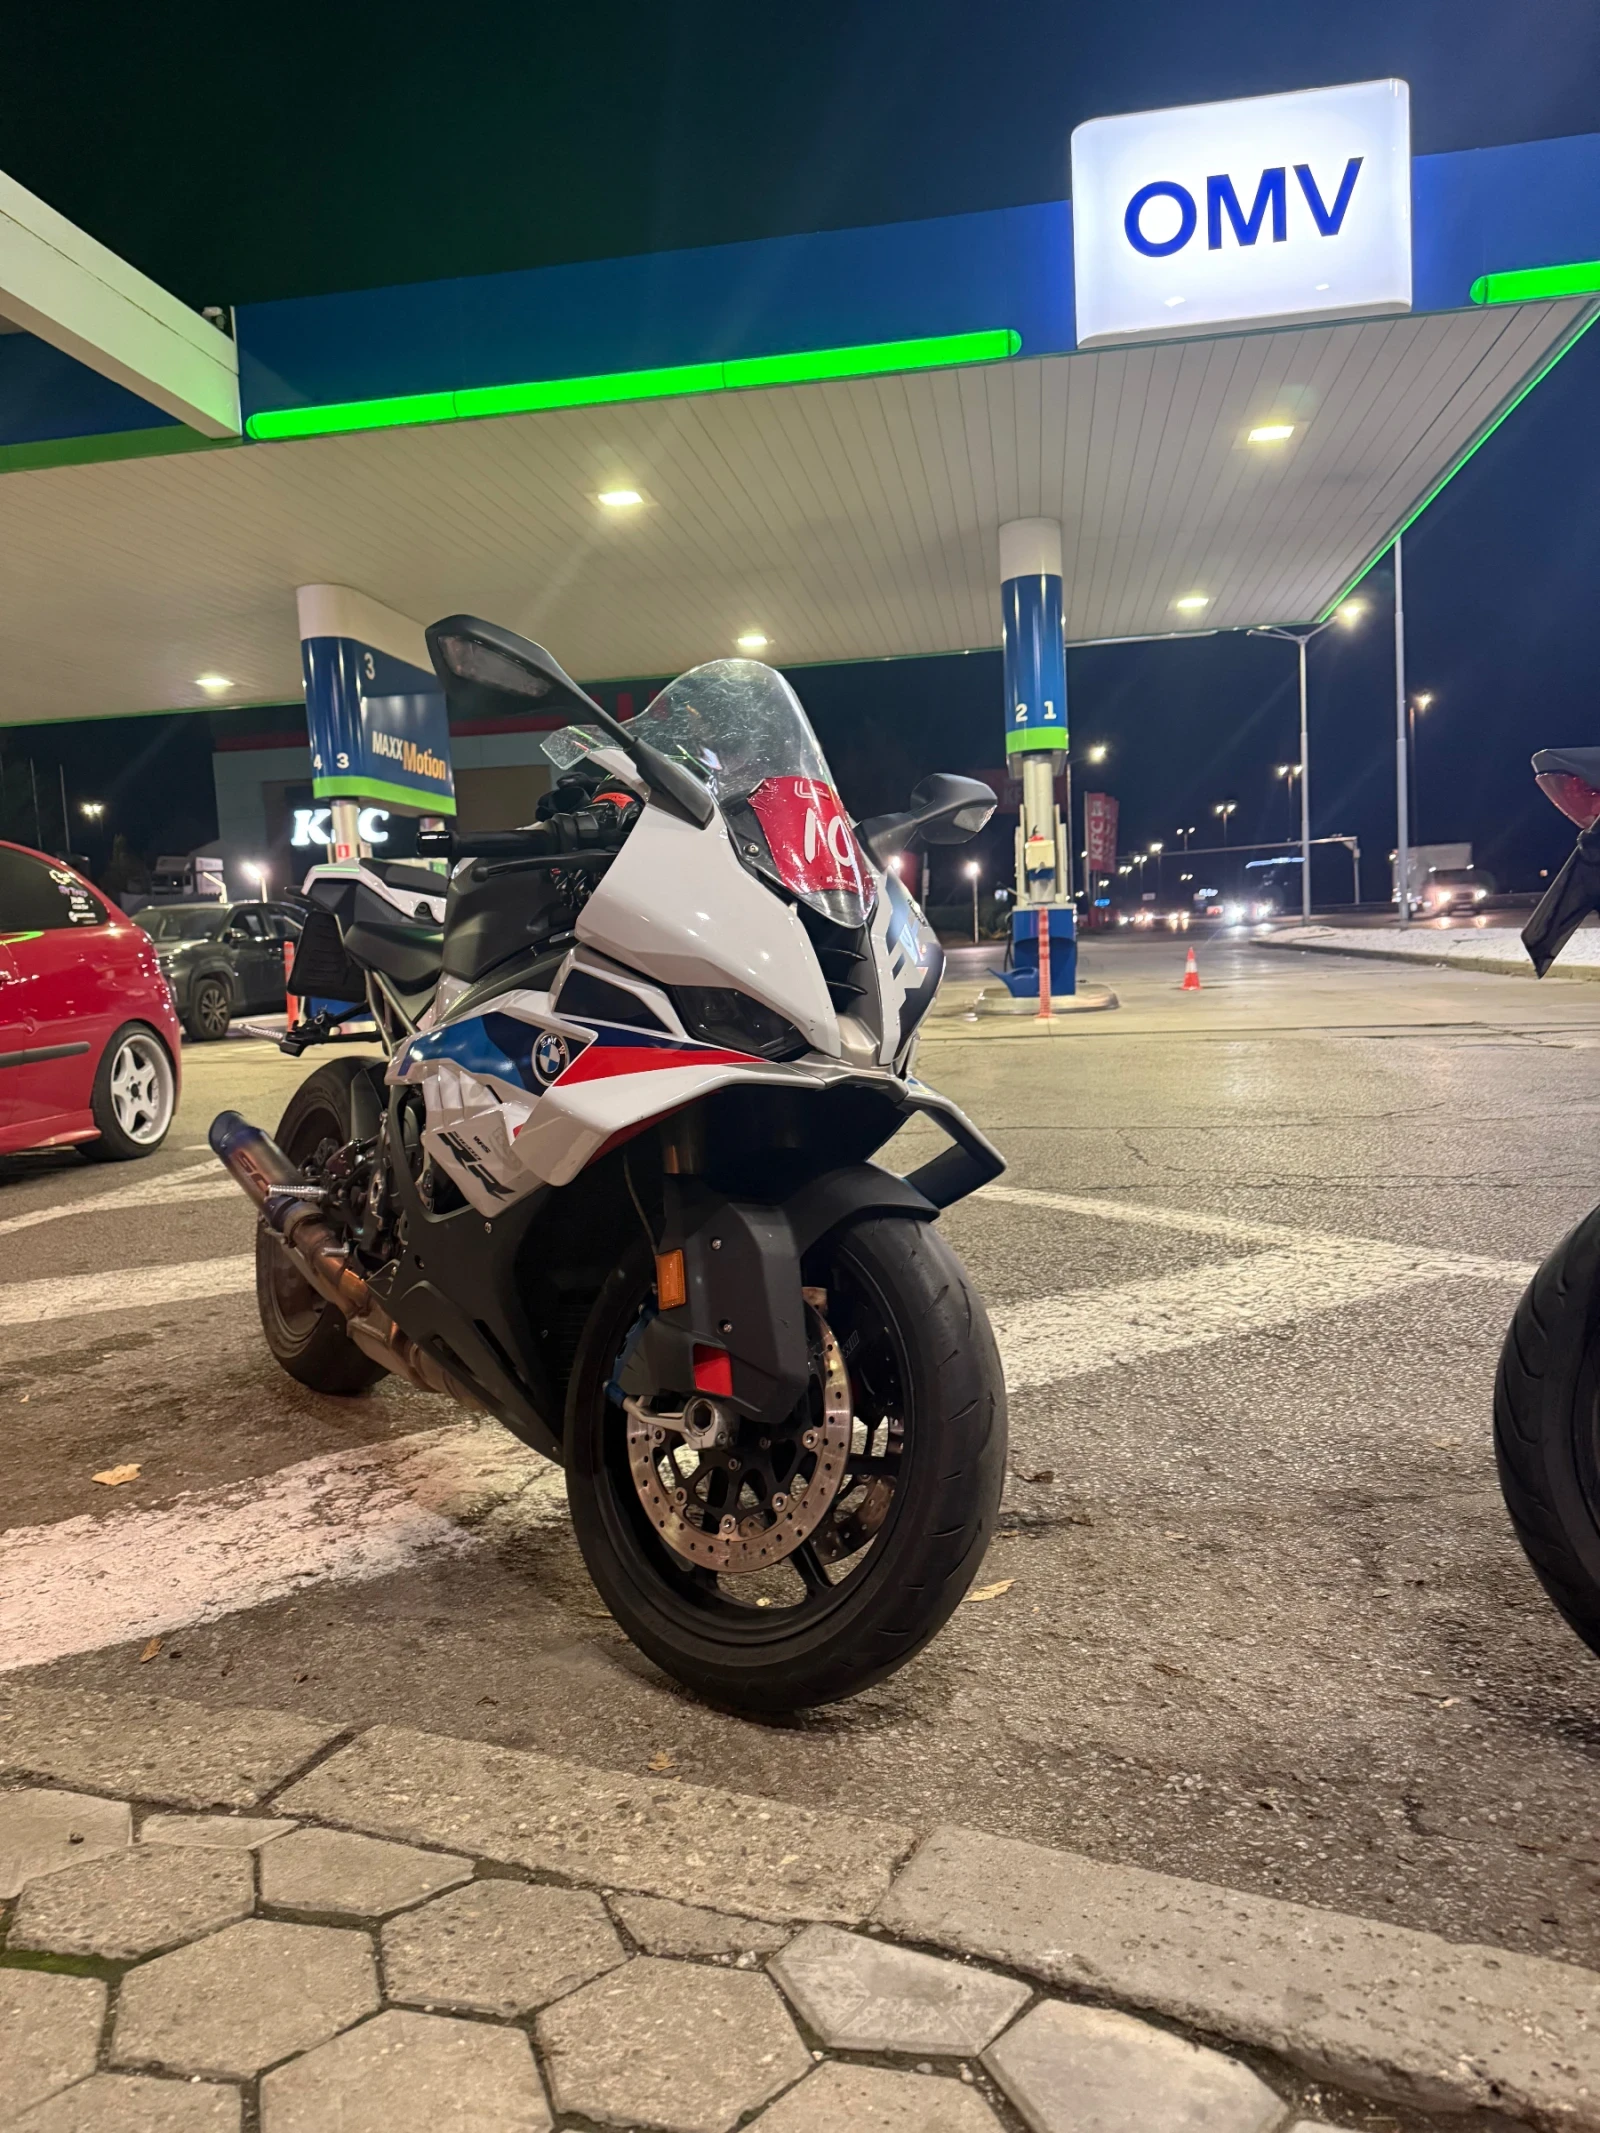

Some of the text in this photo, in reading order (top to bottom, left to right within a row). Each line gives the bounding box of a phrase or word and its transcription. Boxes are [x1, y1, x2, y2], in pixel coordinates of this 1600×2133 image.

[1124, 156, 1364, 258] OMV
[364, 652, 376, 680] 3
[1015, 700, 1057, 723] 2 1
[313, 752, 349, 770] 4 3
[290, 807, 390, 846] KC
[1091, 820, 1103, 861] KFC
[437, 1132, 516, 1202] RR
